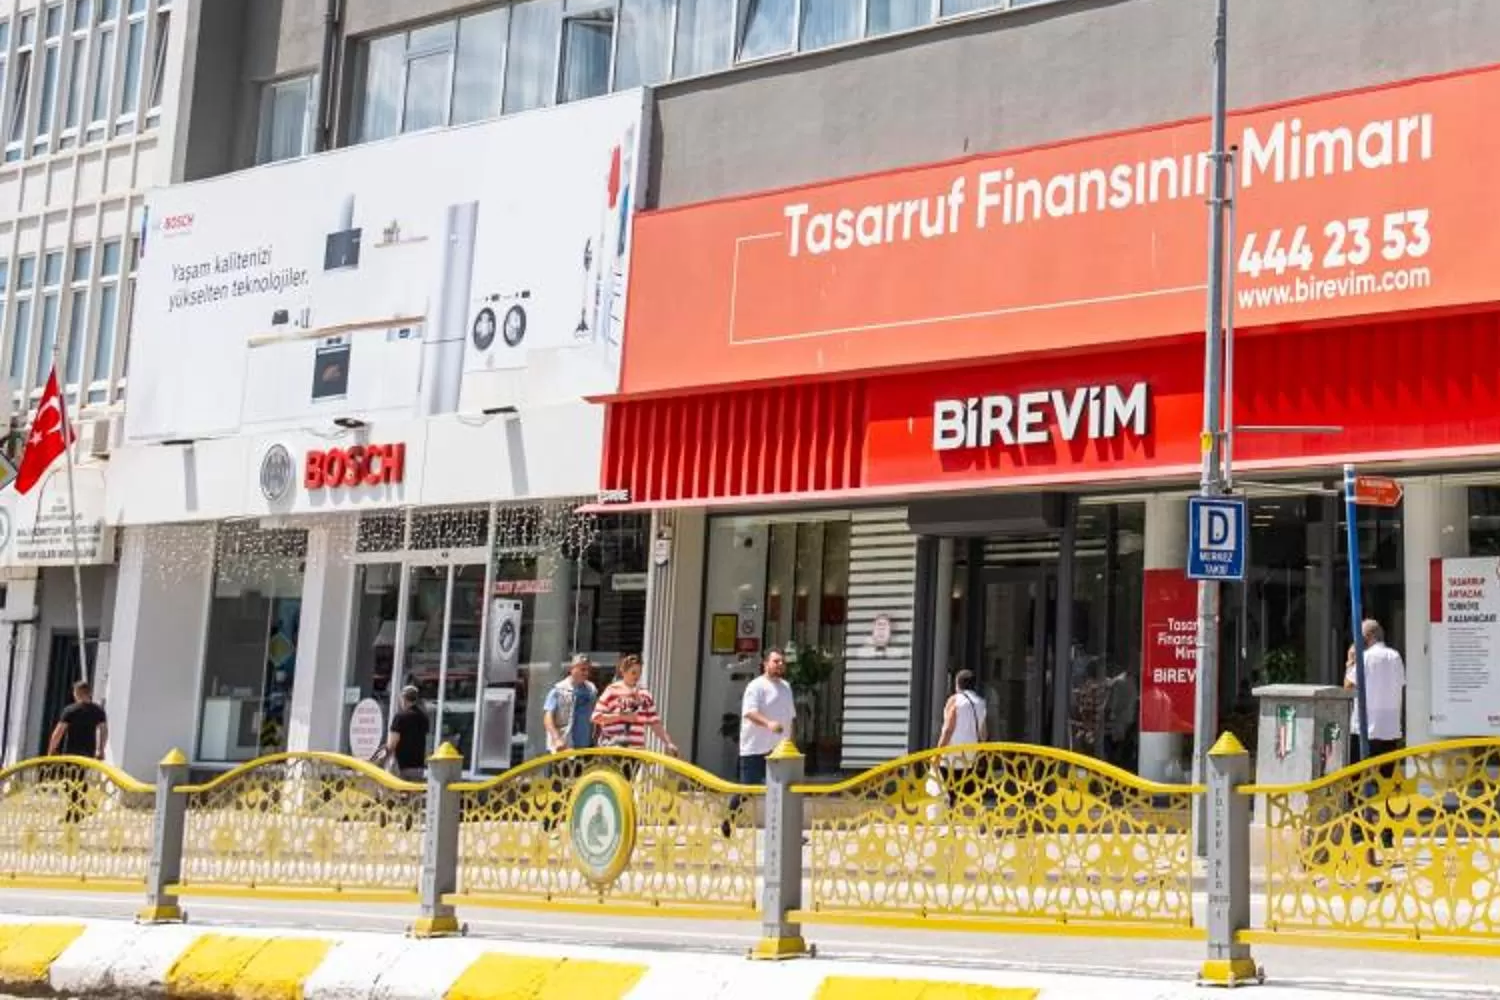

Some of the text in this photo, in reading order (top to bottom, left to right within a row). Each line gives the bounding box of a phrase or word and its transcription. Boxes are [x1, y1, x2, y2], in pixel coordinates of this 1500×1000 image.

[784, 176, 965, 257] Tasarruf
[1241, 113, 1433, 189] Mimarı
[1238, 207, 1431, 278] 444 23 53
[172, 244, 273, 282] Yaşam kalitenizi
[169, 283, 229, 312] yükselten
[1238, 266, 1431, 309] www.birevim.com
[304, 441, 406, 490] BOSCH
[1208, 509, 1230, 546] D
[1168, 617, 1200, 632] Tasar
[1154, 667, 1198, 683] BİREV
